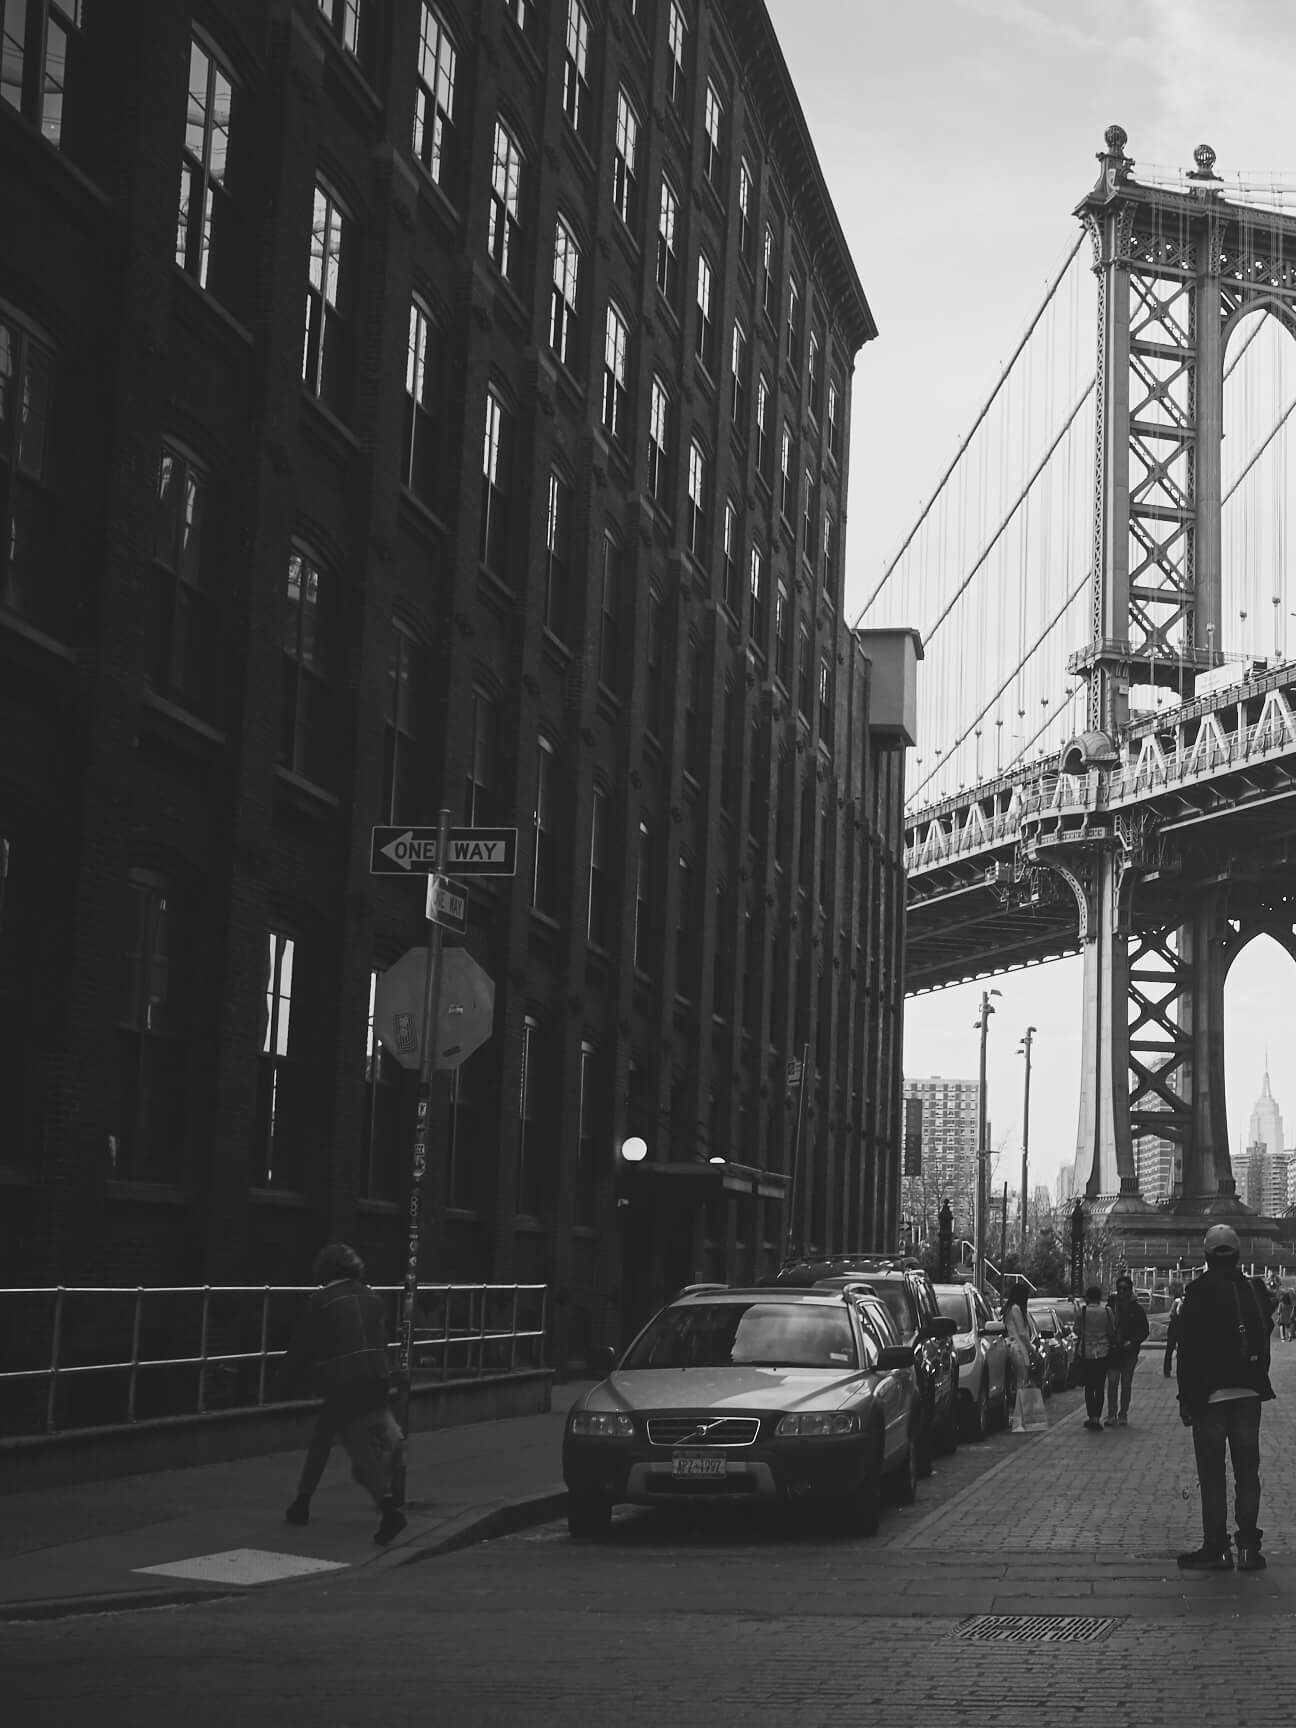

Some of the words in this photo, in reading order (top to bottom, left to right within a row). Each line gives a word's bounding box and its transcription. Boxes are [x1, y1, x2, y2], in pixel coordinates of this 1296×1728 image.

[395, 842, 434, 859] ONE
[454, 842, 497, 860] WAY
[449, 895, 463, 916] WAY
